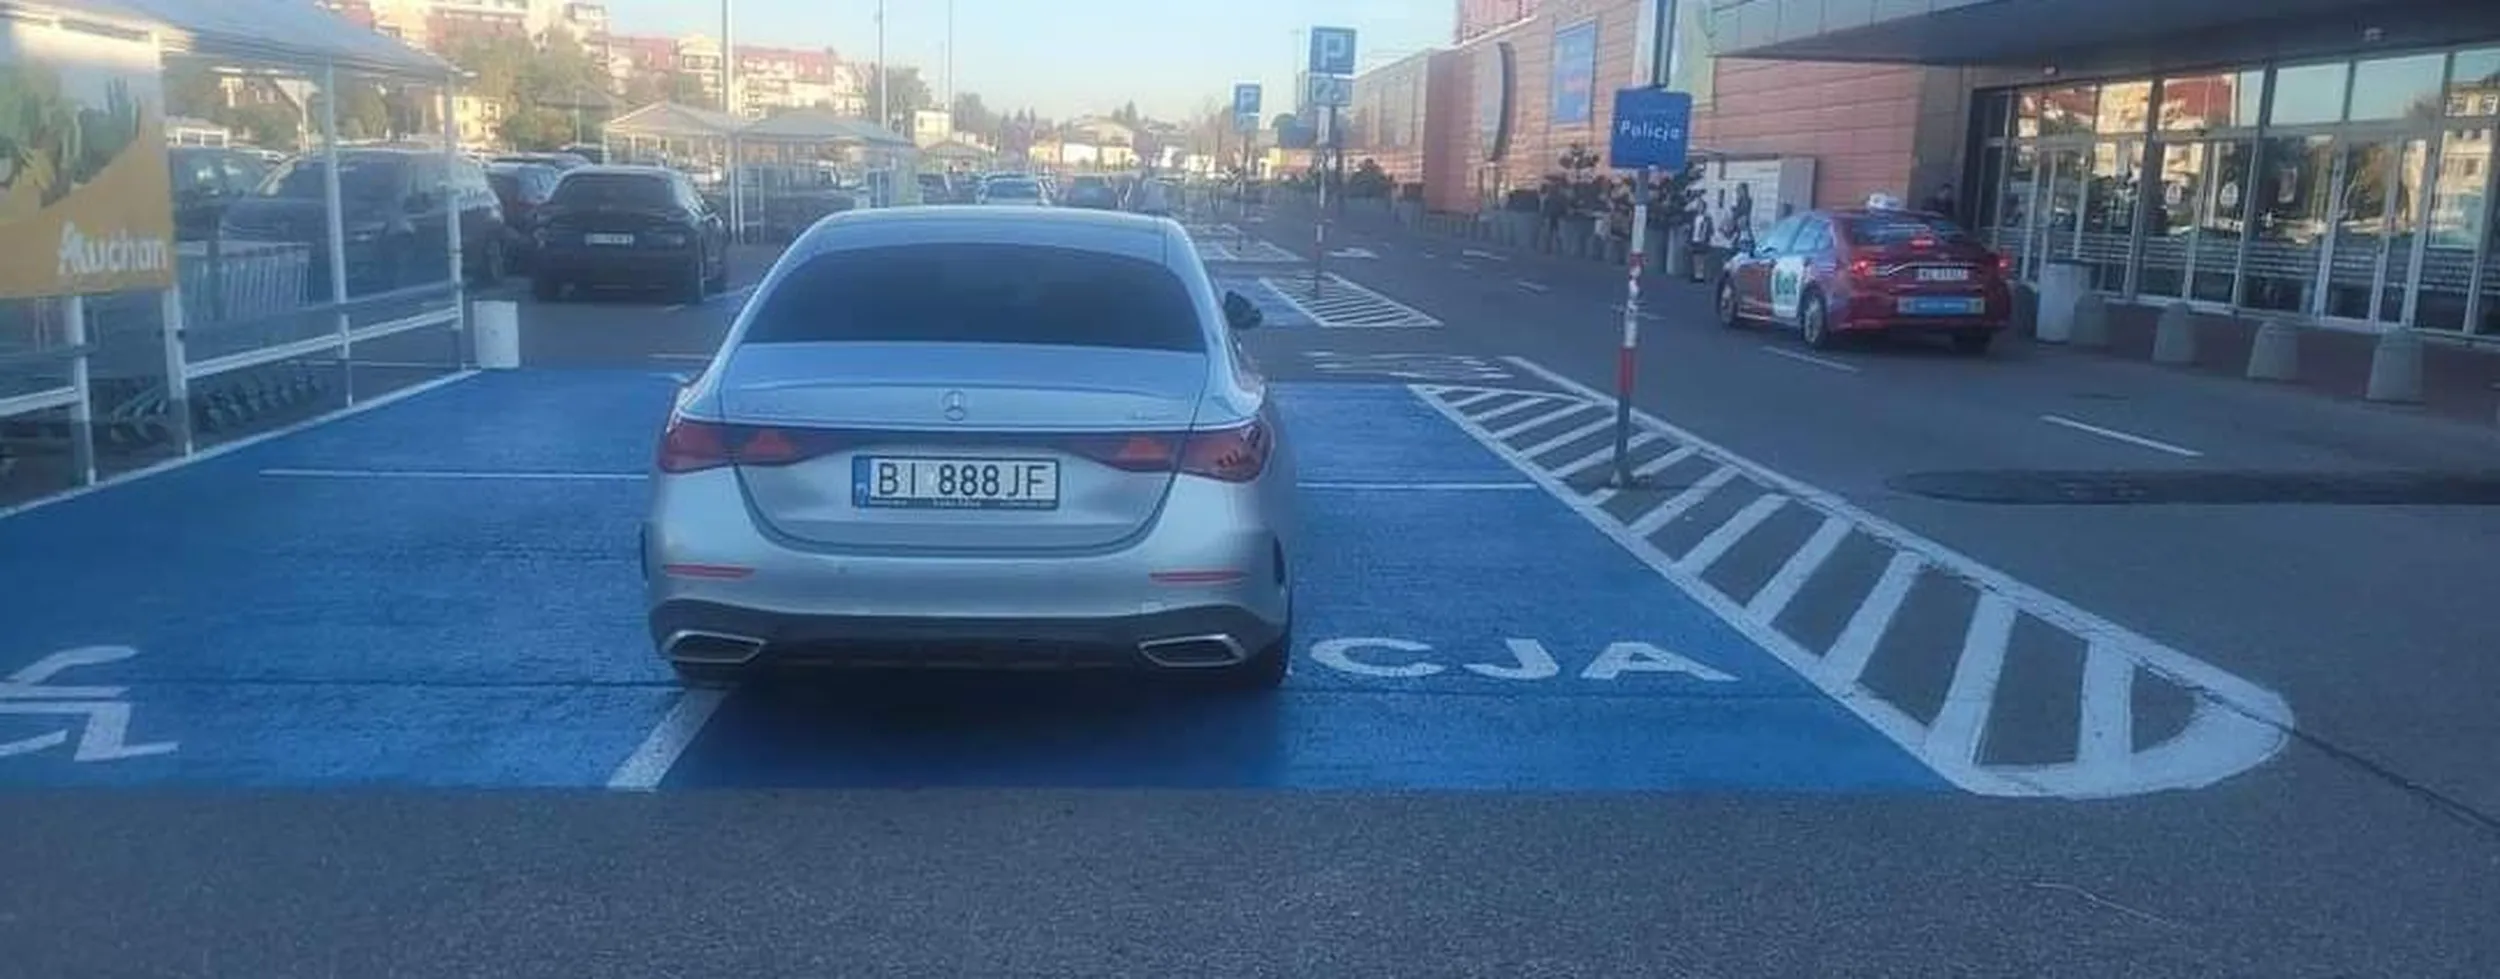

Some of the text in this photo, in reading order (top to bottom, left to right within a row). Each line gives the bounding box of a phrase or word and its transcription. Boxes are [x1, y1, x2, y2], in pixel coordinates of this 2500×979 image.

[1321, 35, 1347, 70] P
[1620, 119, 1681, 142] Policja
[57, 221, 168, 276] Auchan
[878, 462, 1048, 498] BI 888JF
[1286, 637, 1743, 682] CJA
